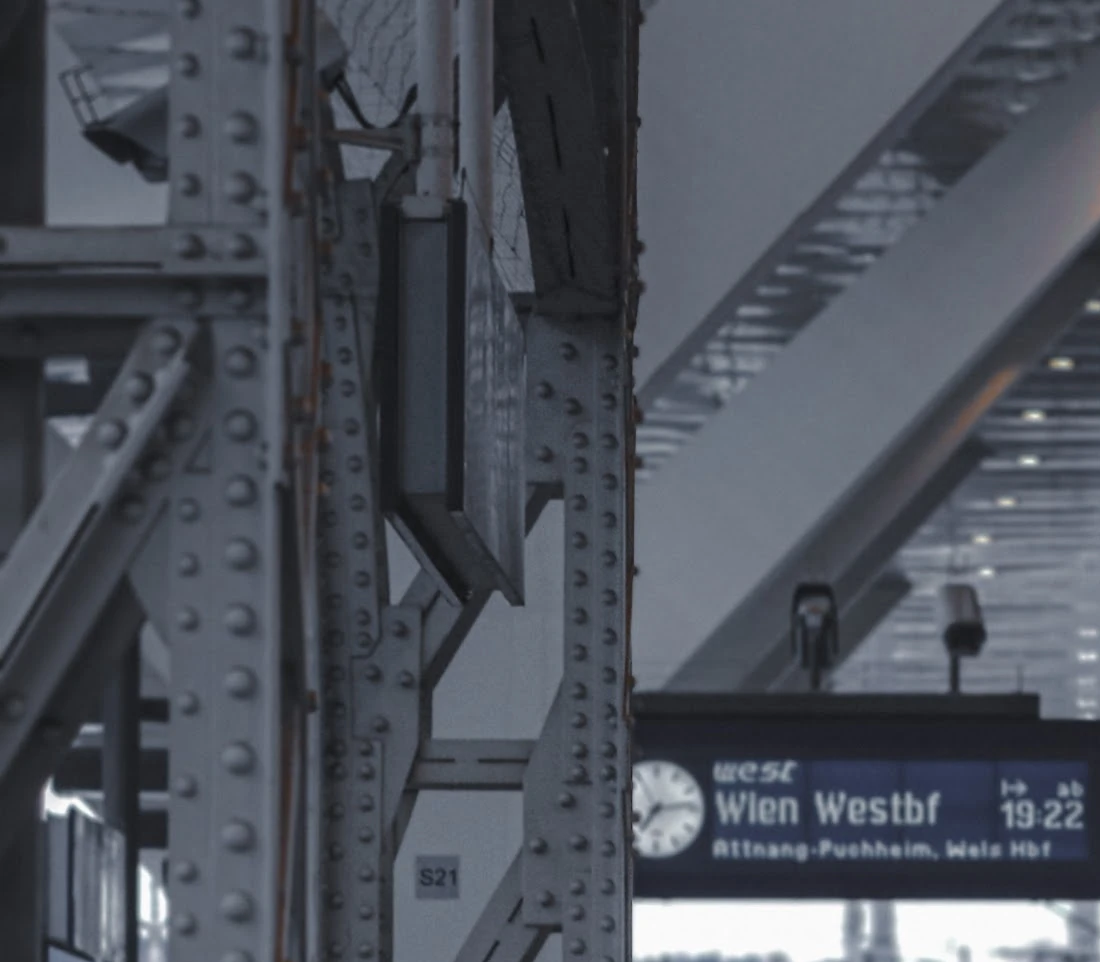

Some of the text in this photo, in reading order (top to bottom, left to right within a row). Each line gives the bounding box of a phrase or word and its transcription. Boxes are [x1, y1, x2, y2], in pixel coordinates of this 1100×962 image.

[712, 759, 798, 783] west
[1056, 779, 1084, 798] ab
[714, 790, 941, 826] Wien Westbf
[1000, 798, 1085, 830] 19:22
[1009, 839, 1052, 859] Hbf
[419, 867, 457, 887] S21
